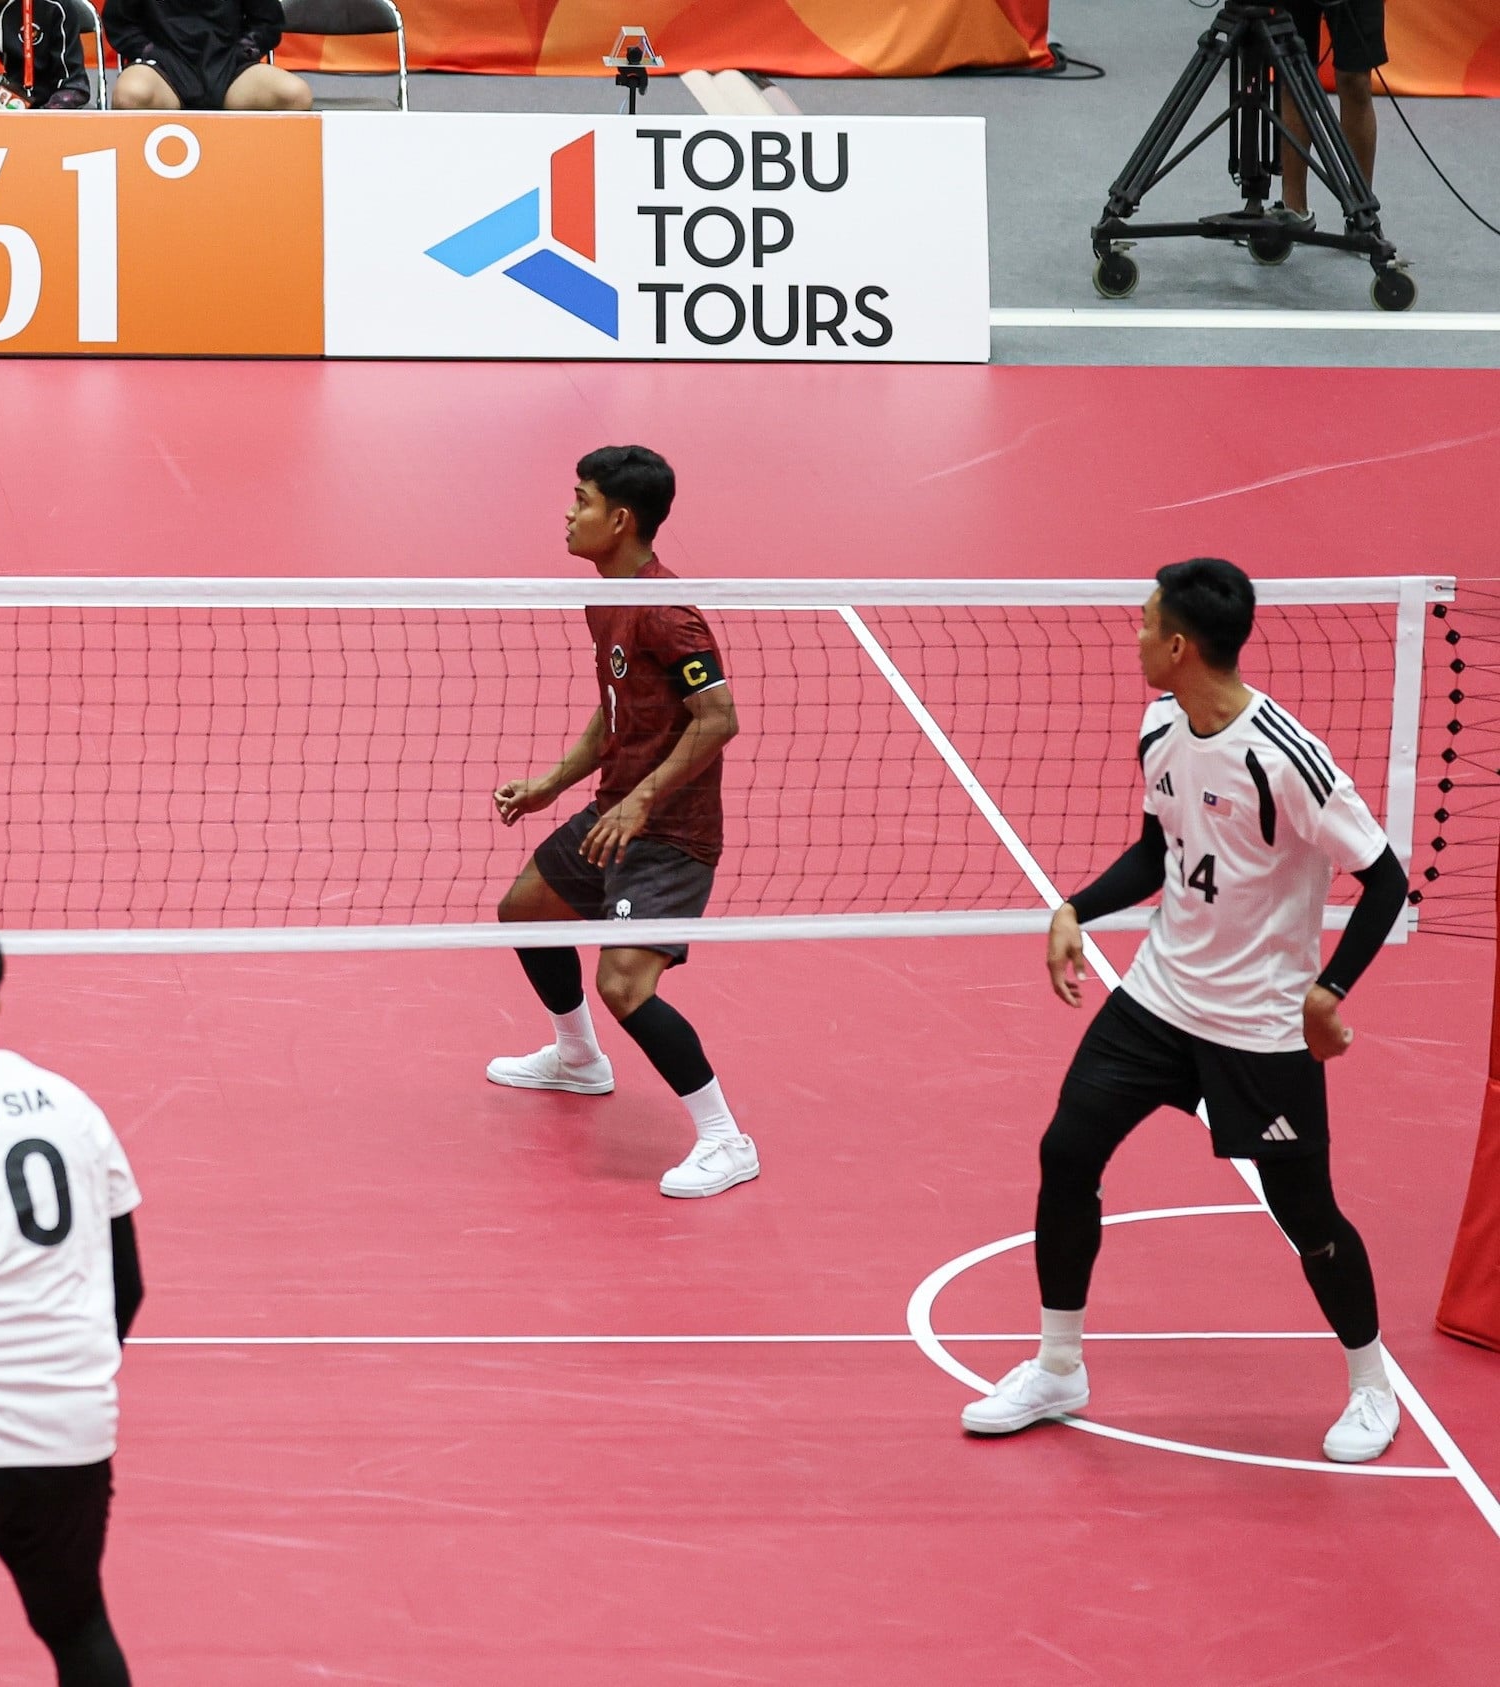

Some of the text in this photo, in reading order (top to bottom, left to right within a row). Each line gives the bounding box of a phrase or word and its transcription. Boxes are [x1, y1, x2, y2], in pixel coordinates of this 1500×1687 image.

[635, 128, 849, 193] TOBU
[637, 205, 795, 269] TOP
[637, 282, 893, 348] TOURS
[683, 661, 708, 687] C
